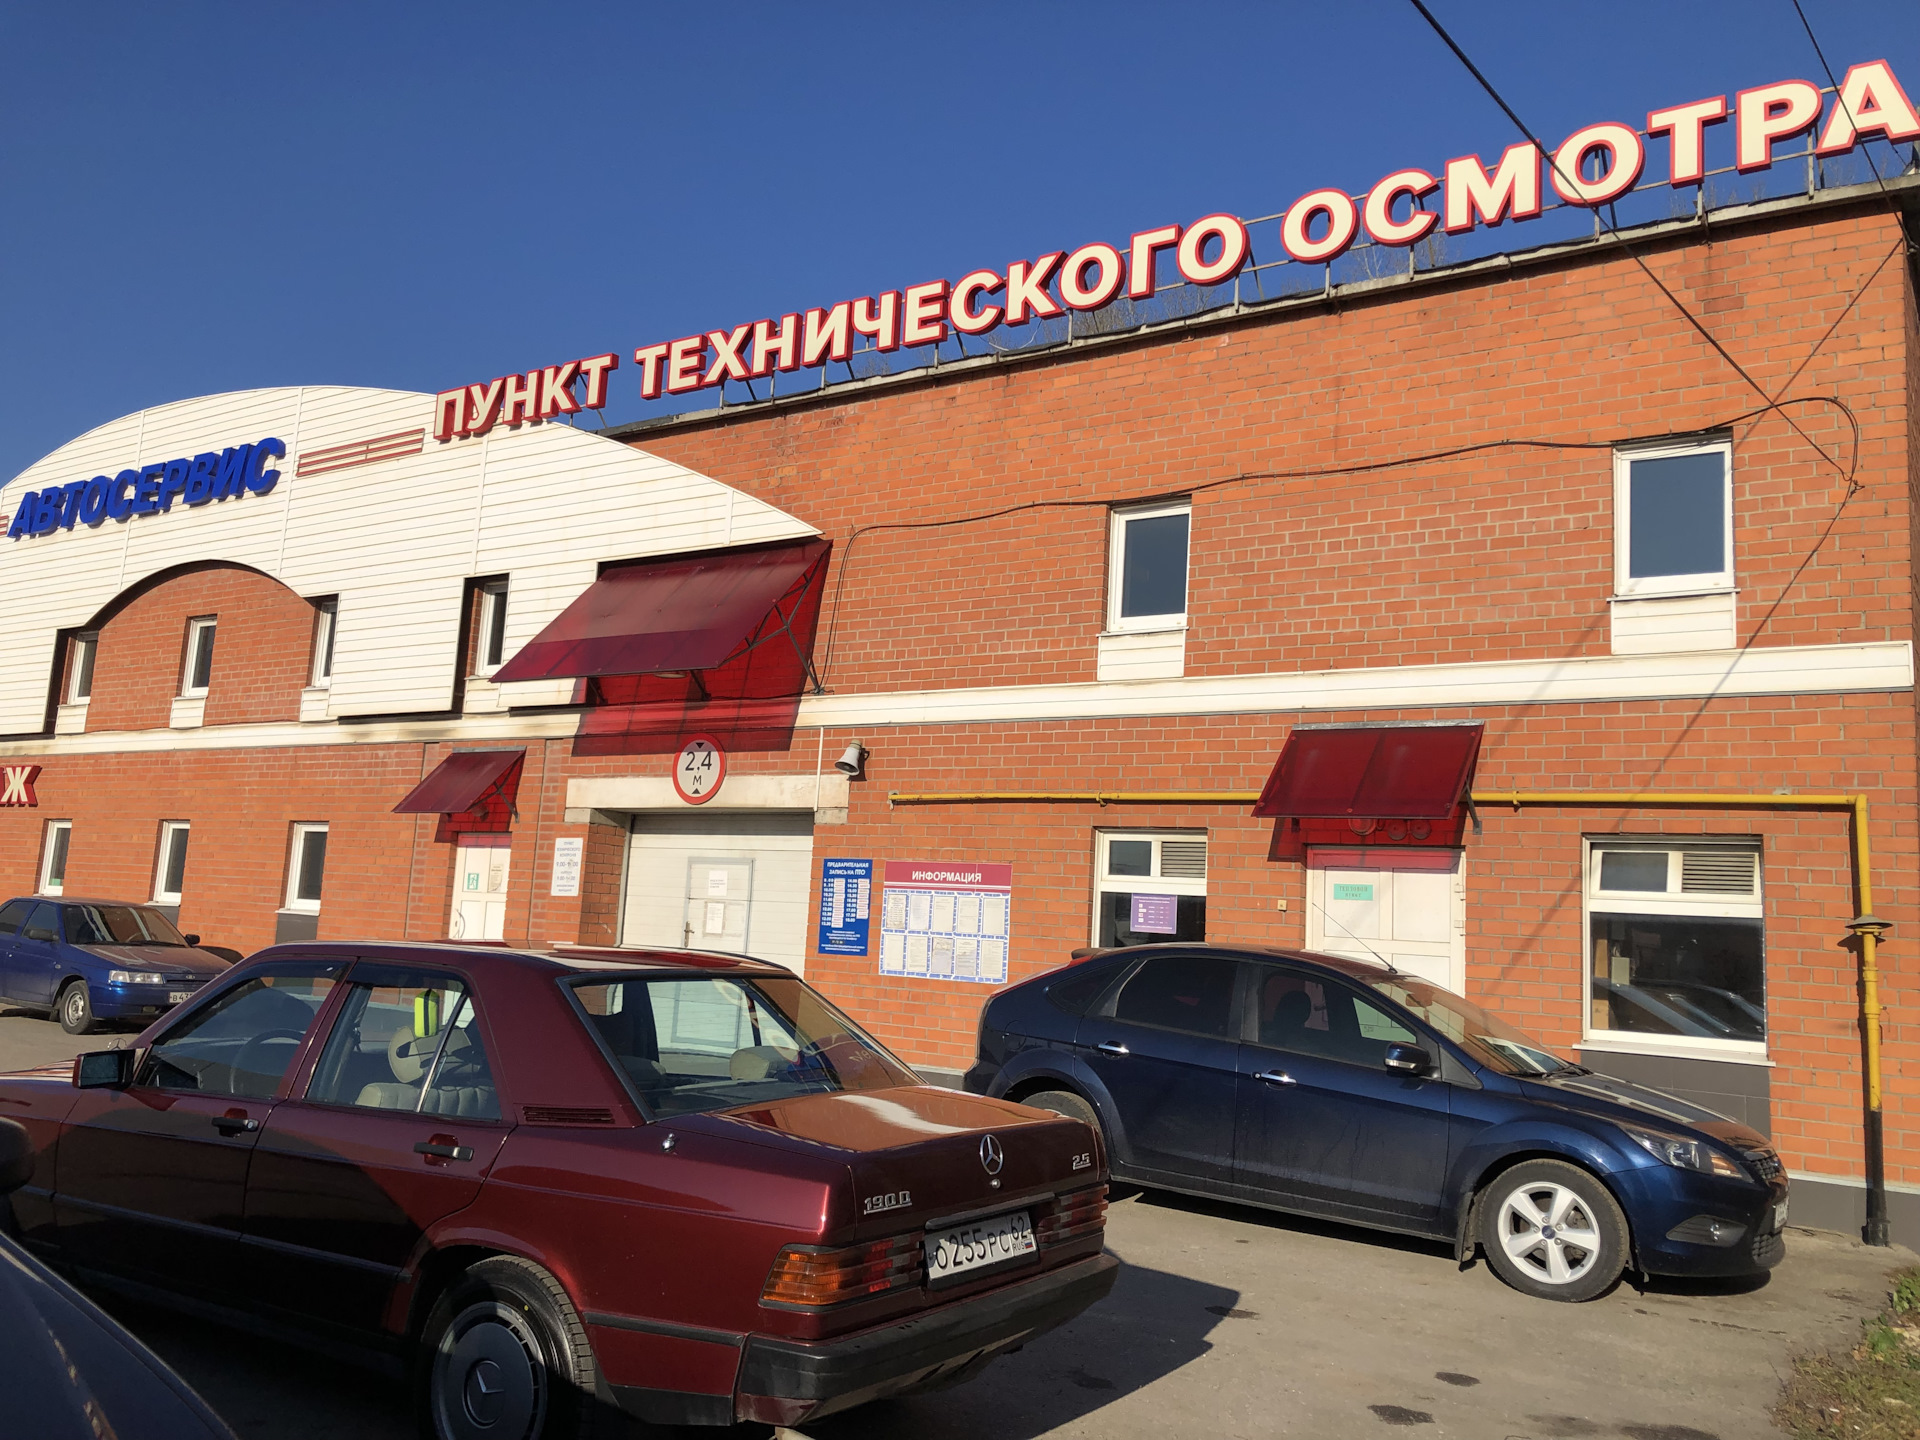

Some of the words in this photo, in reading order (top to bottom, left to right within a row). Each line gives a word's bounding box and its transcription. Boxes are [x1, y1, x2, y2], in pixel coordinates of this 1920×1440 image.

[433, 353, 619, 440] ПУНКТ
[634, 212, 1251, 399] ТЕХНИЧЕСКОГО
[1280, 59, 1920, 264] ОСМОТРА
[7, 437, 286, 540] АВТОСЕРВИС
[692, 774, 702, 786] М
[912, 871, 982, 883] ИНФОРМАЦИЯ
[936, 1228, 1010, 1269] О255РС
[1010, 1216, 1028, 1241] 62
[1012, 1240, 1025, 1251] RUS
